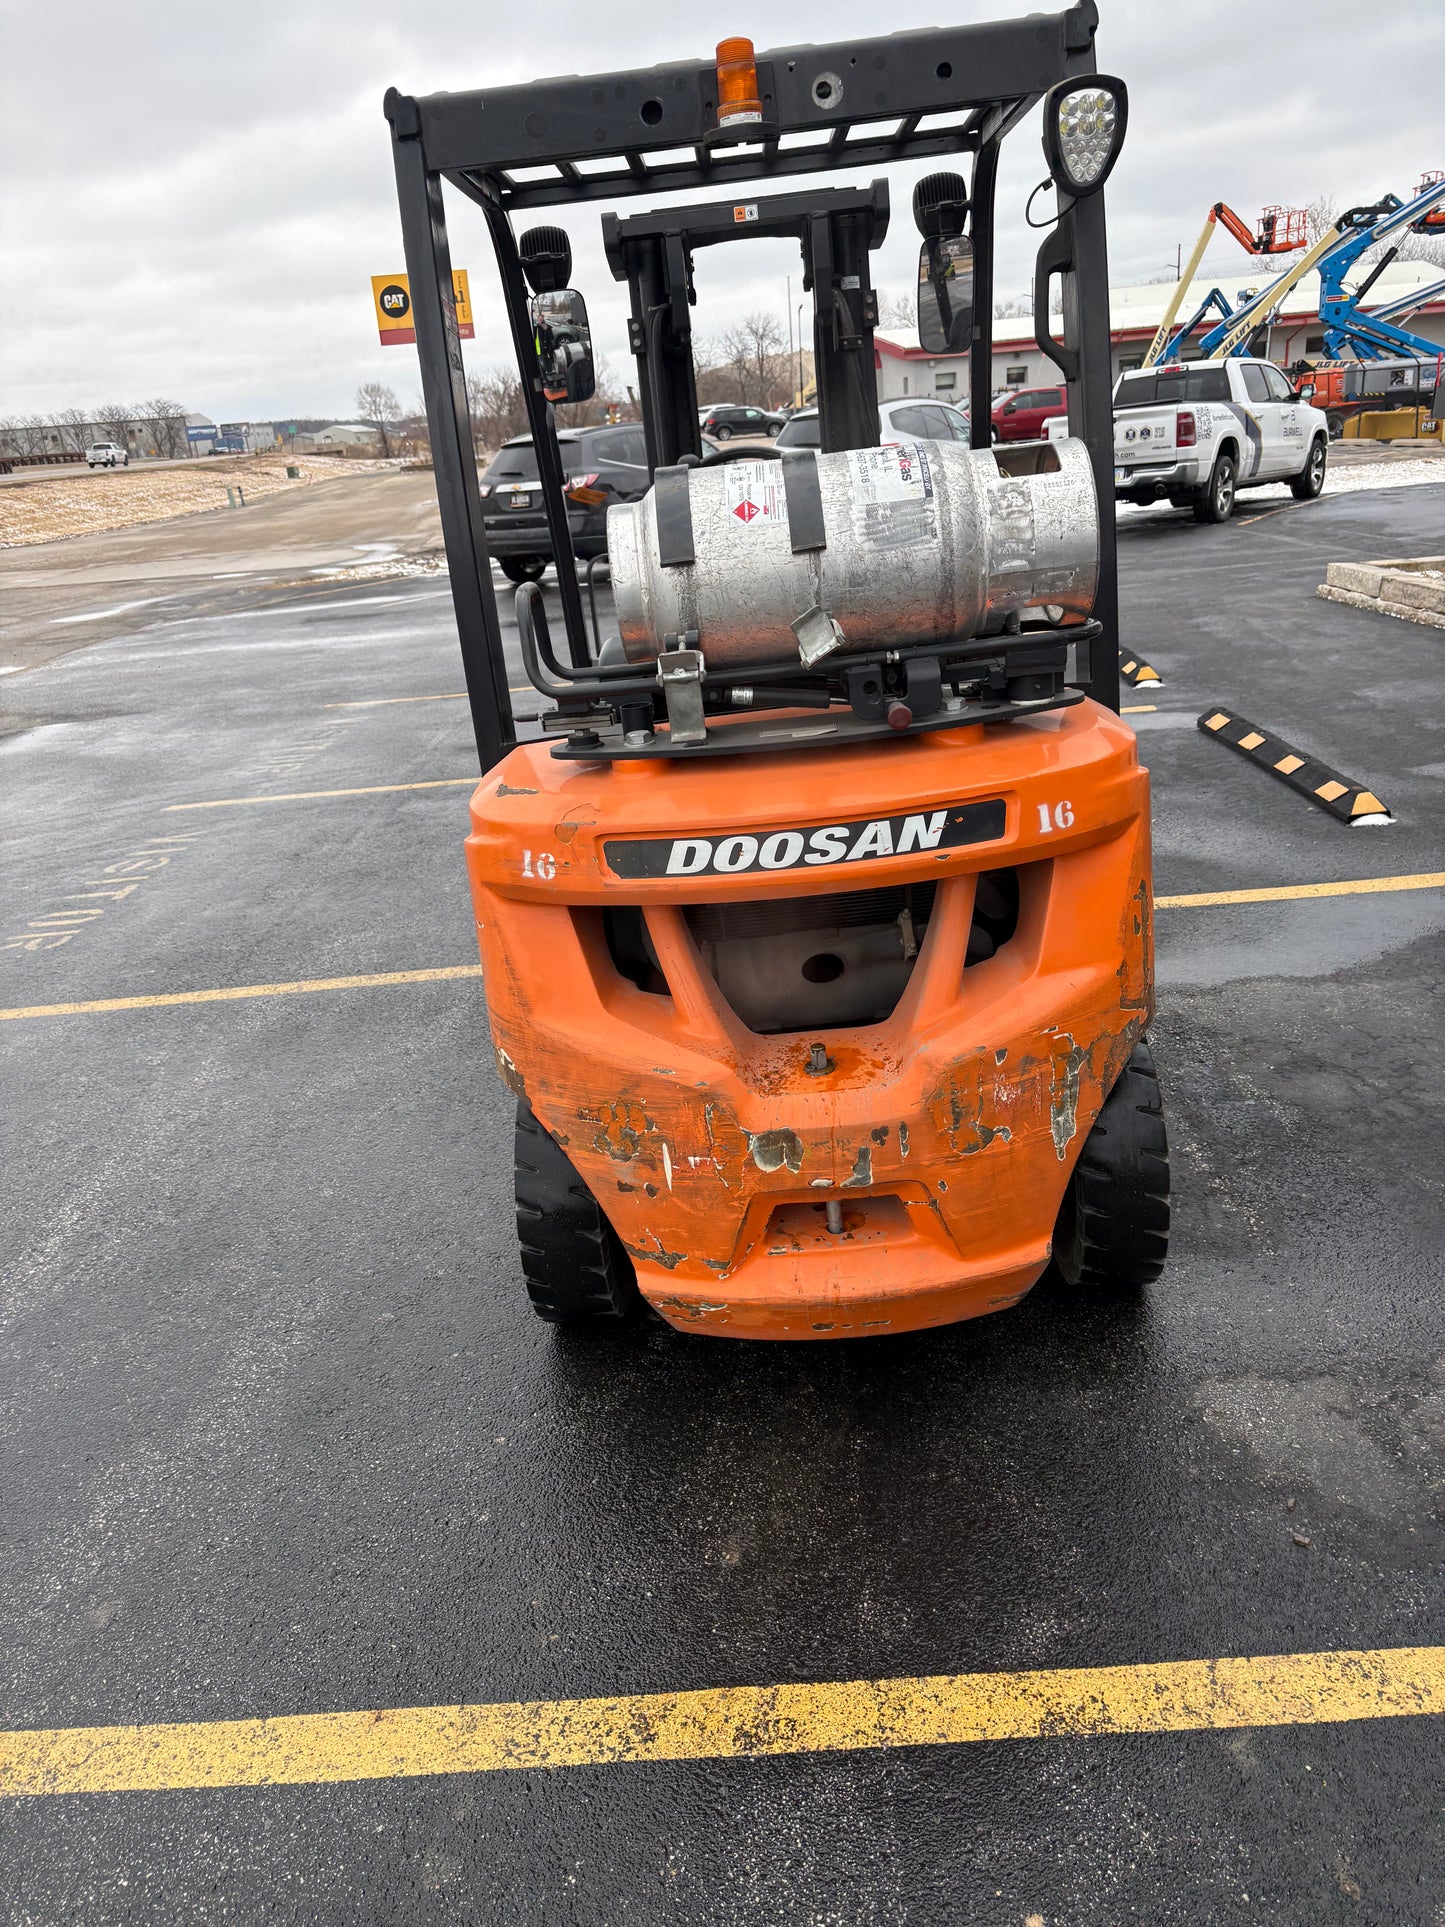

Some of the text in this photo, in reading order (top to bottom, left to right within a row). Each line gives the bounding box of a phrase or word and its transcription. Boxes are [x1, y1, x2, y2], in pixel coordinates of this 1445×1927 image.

[383, 293, 404, 309] CAT
[1149, 326, 1167, 363] JLG LIFT
[1222, 321, 1251, 355] JLG LIFT
[1421, 421, 1437, 433] CAT
[1037, 800, 1075, 834] 16
[665, 810, 948, 875] DOOSAN
[522, 849, 557, 880] 16
